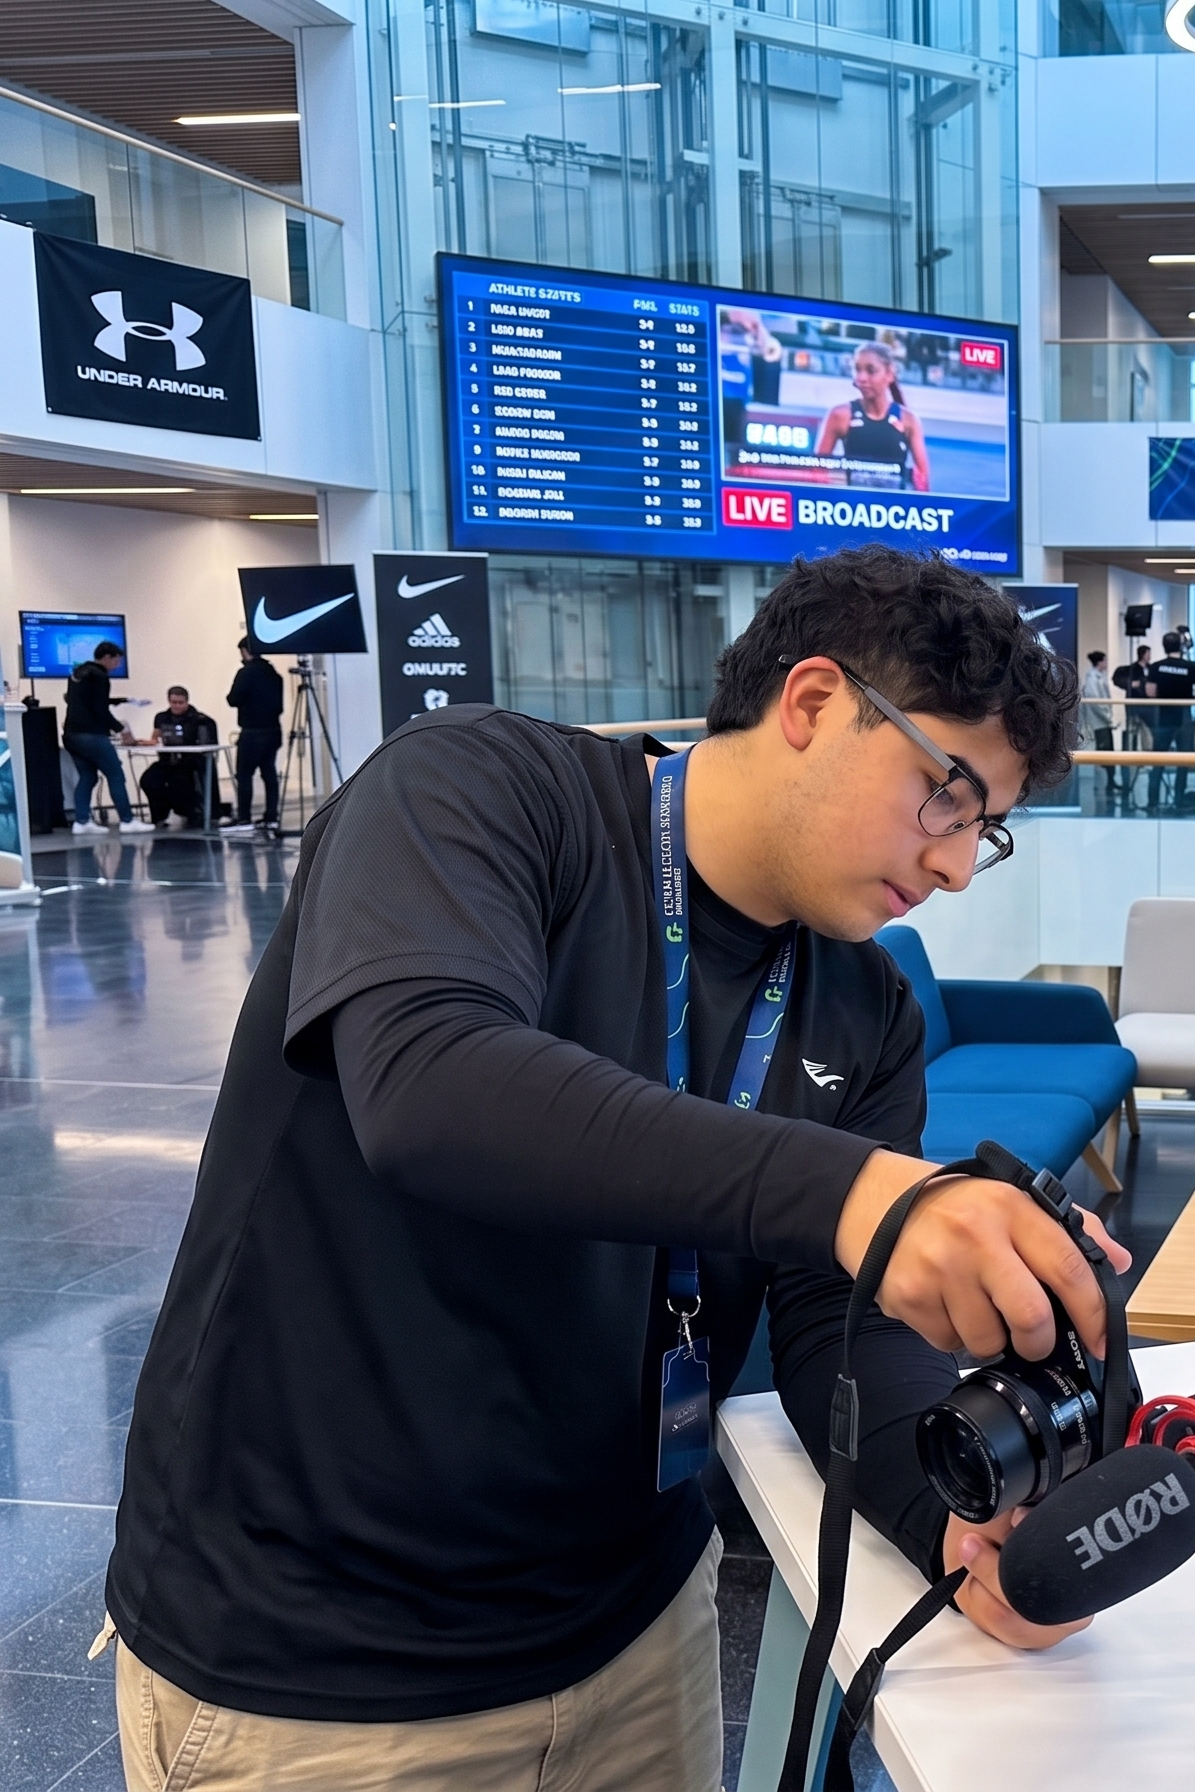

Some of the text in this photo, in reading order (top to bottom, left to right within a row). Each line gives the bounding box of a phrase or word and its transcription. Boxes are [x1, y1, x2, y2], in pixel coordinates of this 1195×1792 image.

[965, 348, 996, 364] LIVE
[77, 365, 142, 388] UNDER
[729, 495, 955, 533] LIVE BROADCAST
[407, 634, 461, 648] adidas
[1065, 1472, 1192, 1571] RØDE
